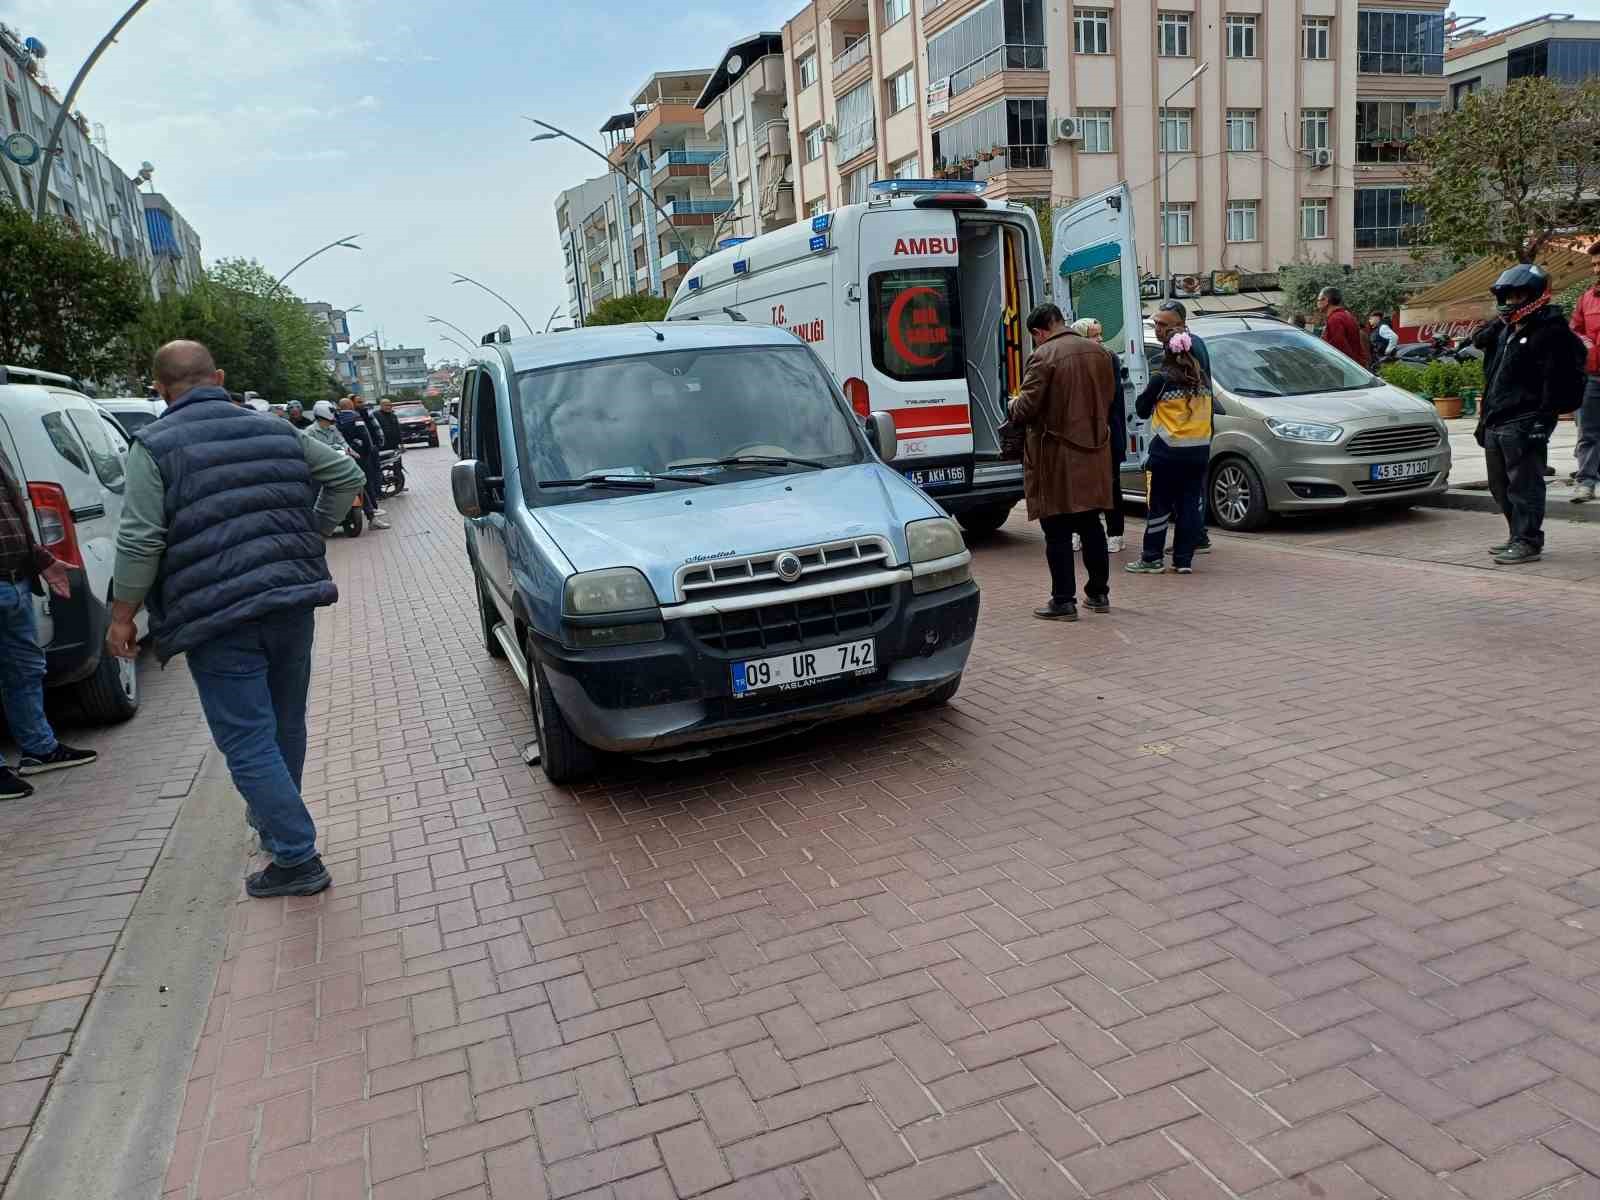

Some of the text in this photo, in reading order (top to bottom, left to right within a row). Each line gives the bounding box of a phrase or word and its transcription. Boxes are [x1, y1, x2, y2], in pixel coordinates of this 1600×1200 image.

[771, 304, 787, 326] T.C.
[911, 466, 963, 484] 45 AKH 166
[1377, 462, 1427, 478] 45 SB 7130
[746, 662, 771, 686] 09
[792, 653, 816, 678] UR
[837, 643, 873, 669] 742
